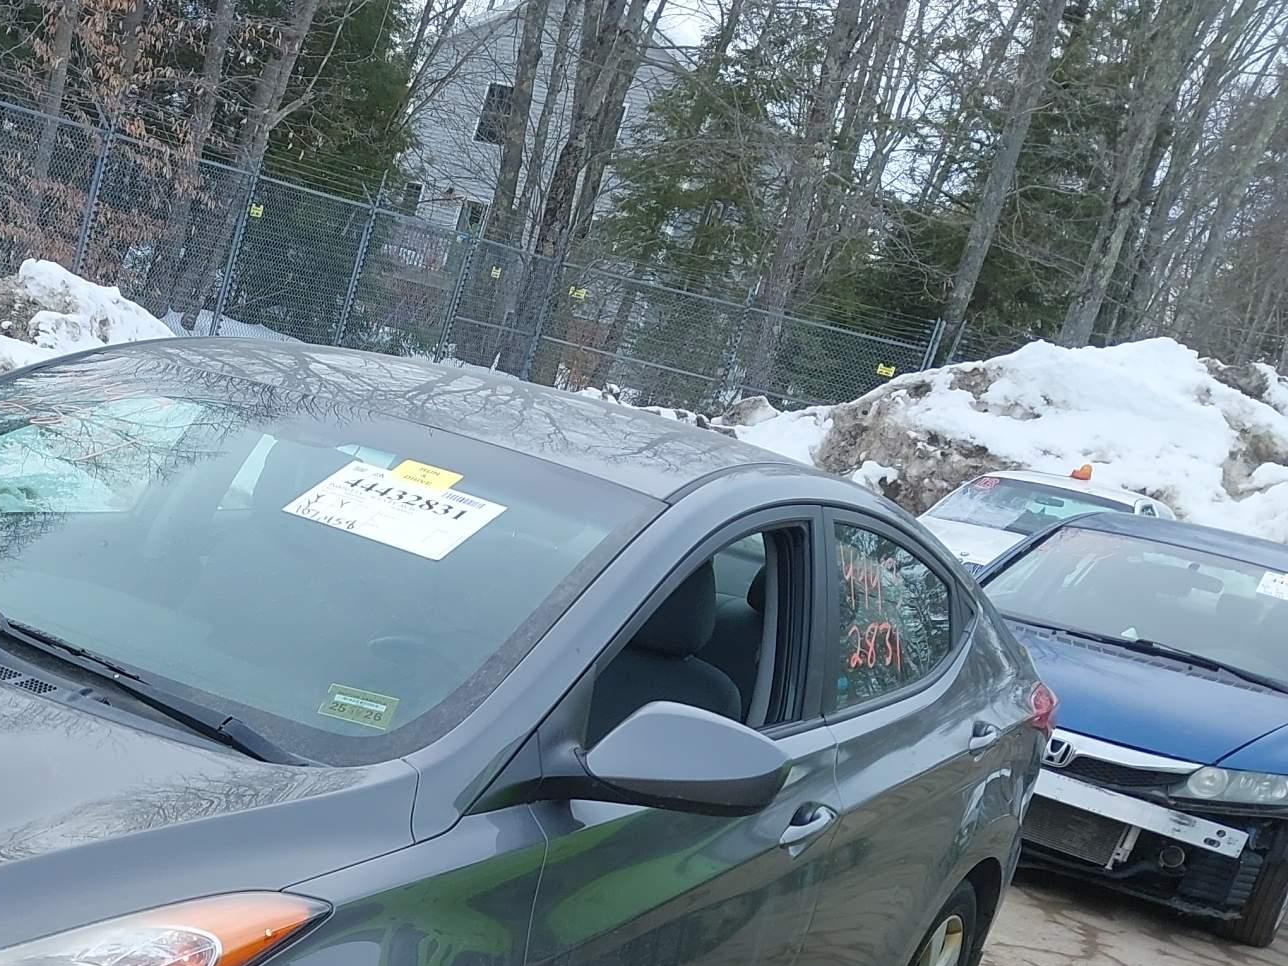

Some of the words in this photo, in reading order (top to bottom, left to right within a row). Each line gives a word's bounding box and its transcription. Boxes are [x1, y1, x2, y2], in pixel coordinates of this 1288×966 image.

[344, 478, 468, 520] 44432831
[848, 619, 902, 673] 2831
[363, 710, 383, 721] 26
